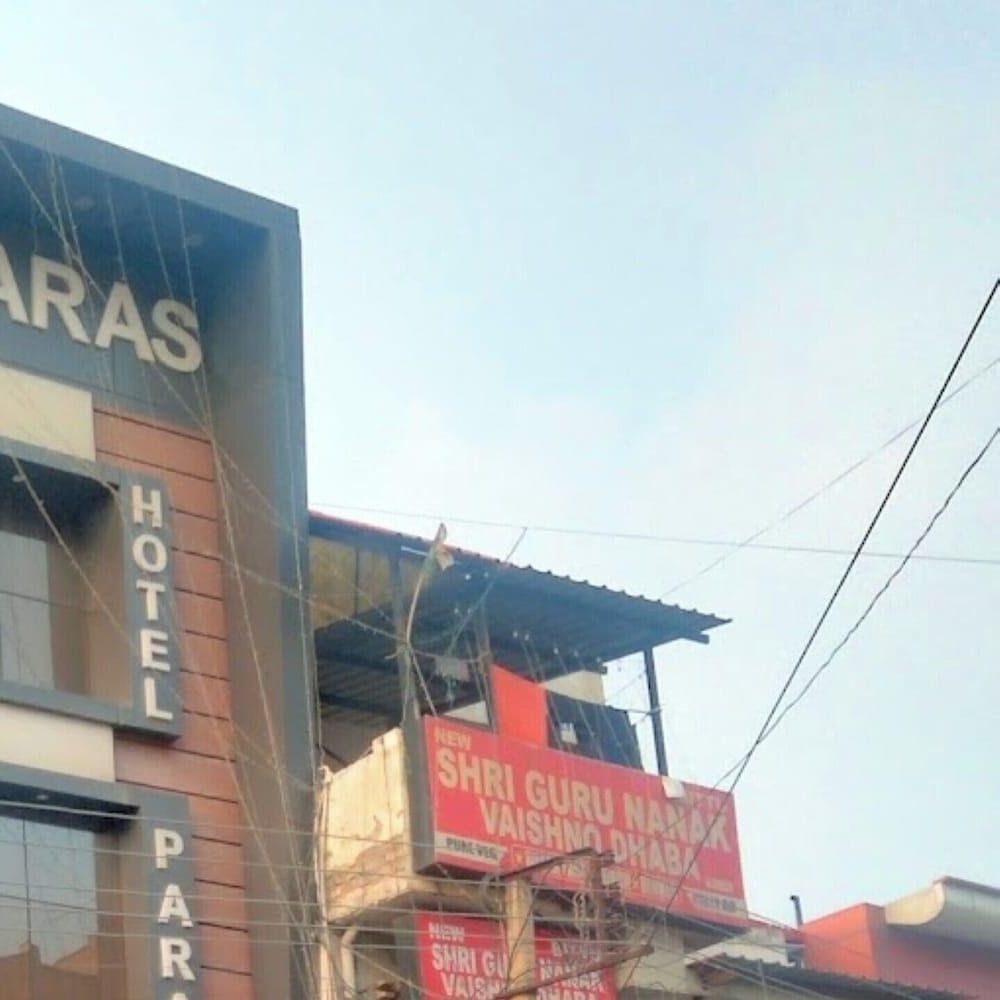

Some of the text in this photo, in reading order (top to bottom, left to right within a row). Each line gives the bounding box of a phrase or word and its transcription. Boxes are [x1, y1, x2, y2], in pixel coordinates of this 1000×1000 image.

[133, 486, 173, 721] HOTEL
[435, 727, 471, 750] NEW
[437, 748, 731, 854] SHRI GURU NANAK
[479, 798, 602, 855] VAISHNO
[611, 829, 700, 881] DHABA
[428, 921, 464, 941] NEW
[432, 943, 477, 975] SHRI
